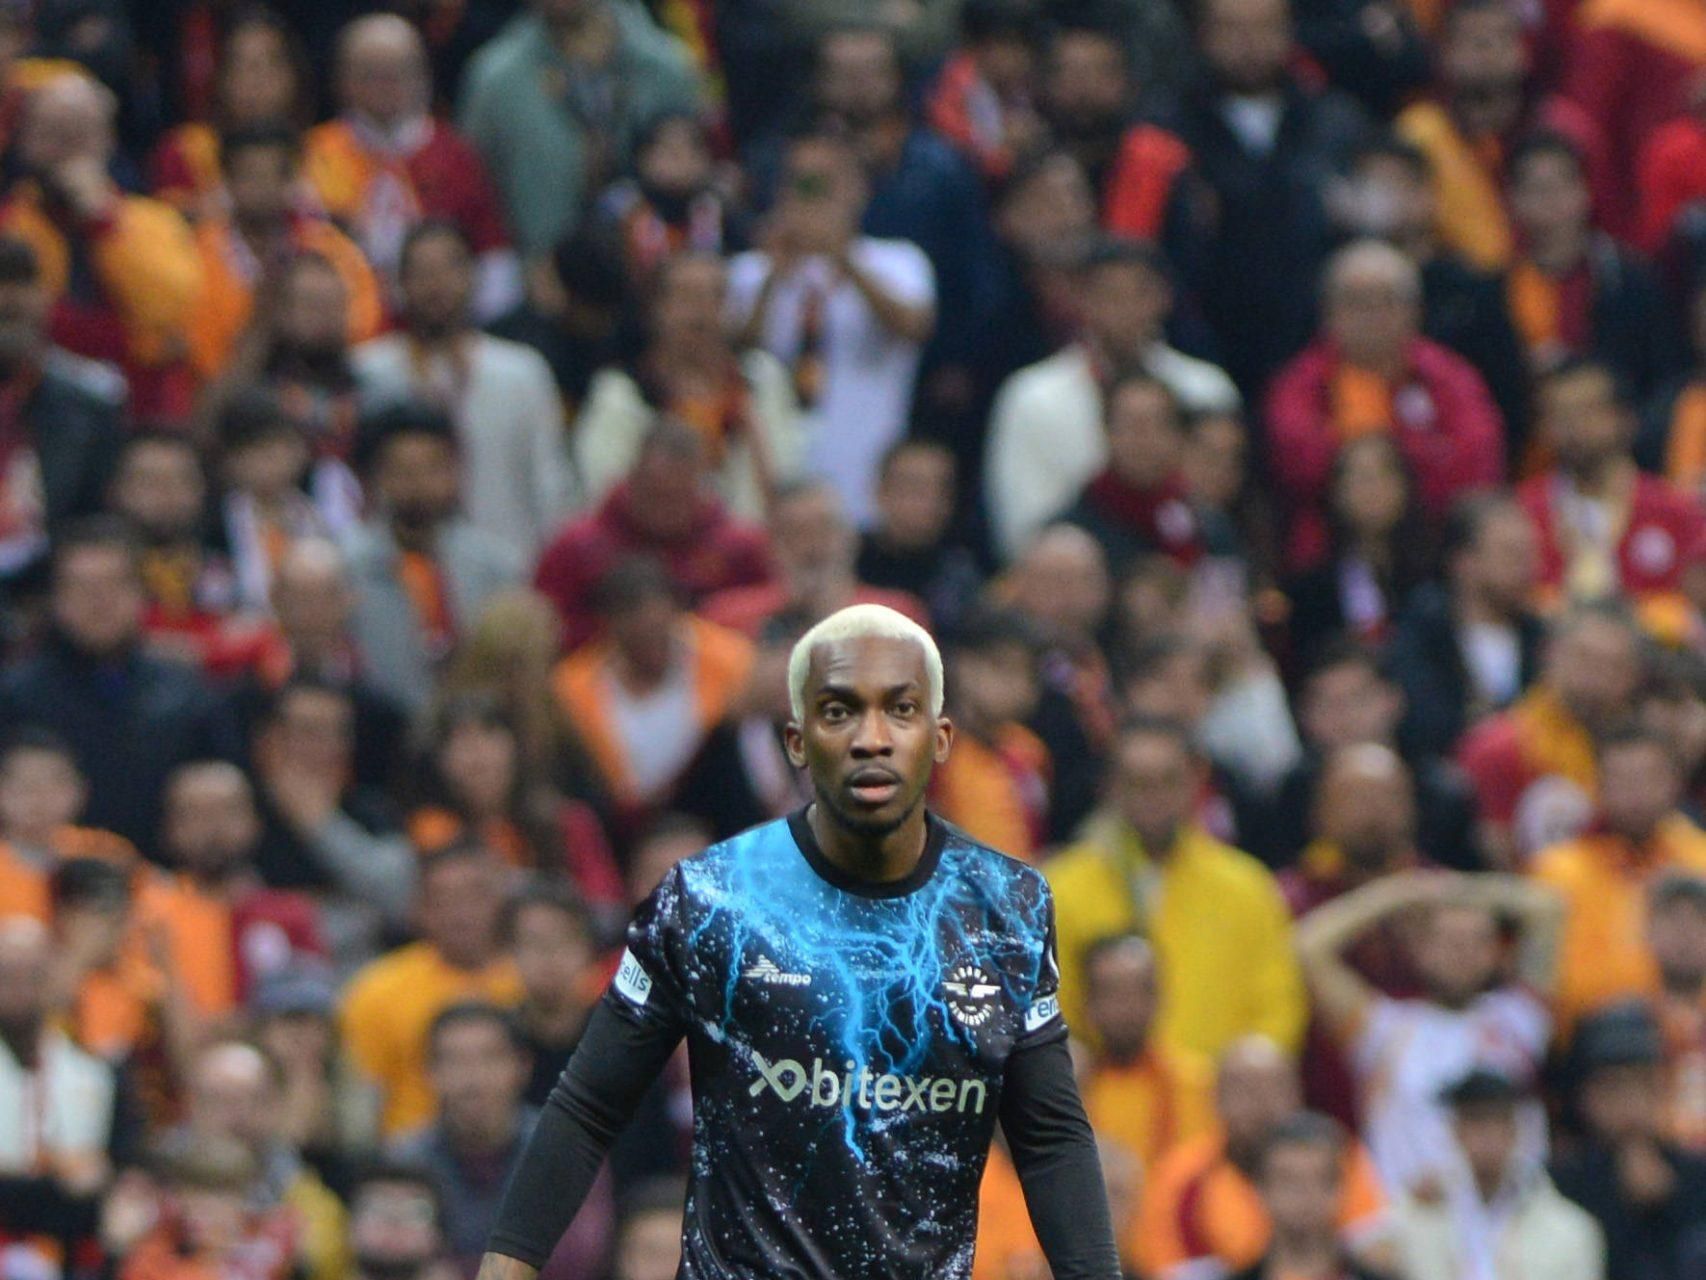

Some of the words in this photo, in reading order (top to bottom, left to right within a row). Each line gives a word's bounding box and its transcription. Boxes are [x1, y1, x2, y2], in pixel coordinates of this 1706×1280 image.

[622, 963, 648, 991] ells
[763, 971, 812, 986] tempo
[812, 1057, 986, 1114] bitexen
